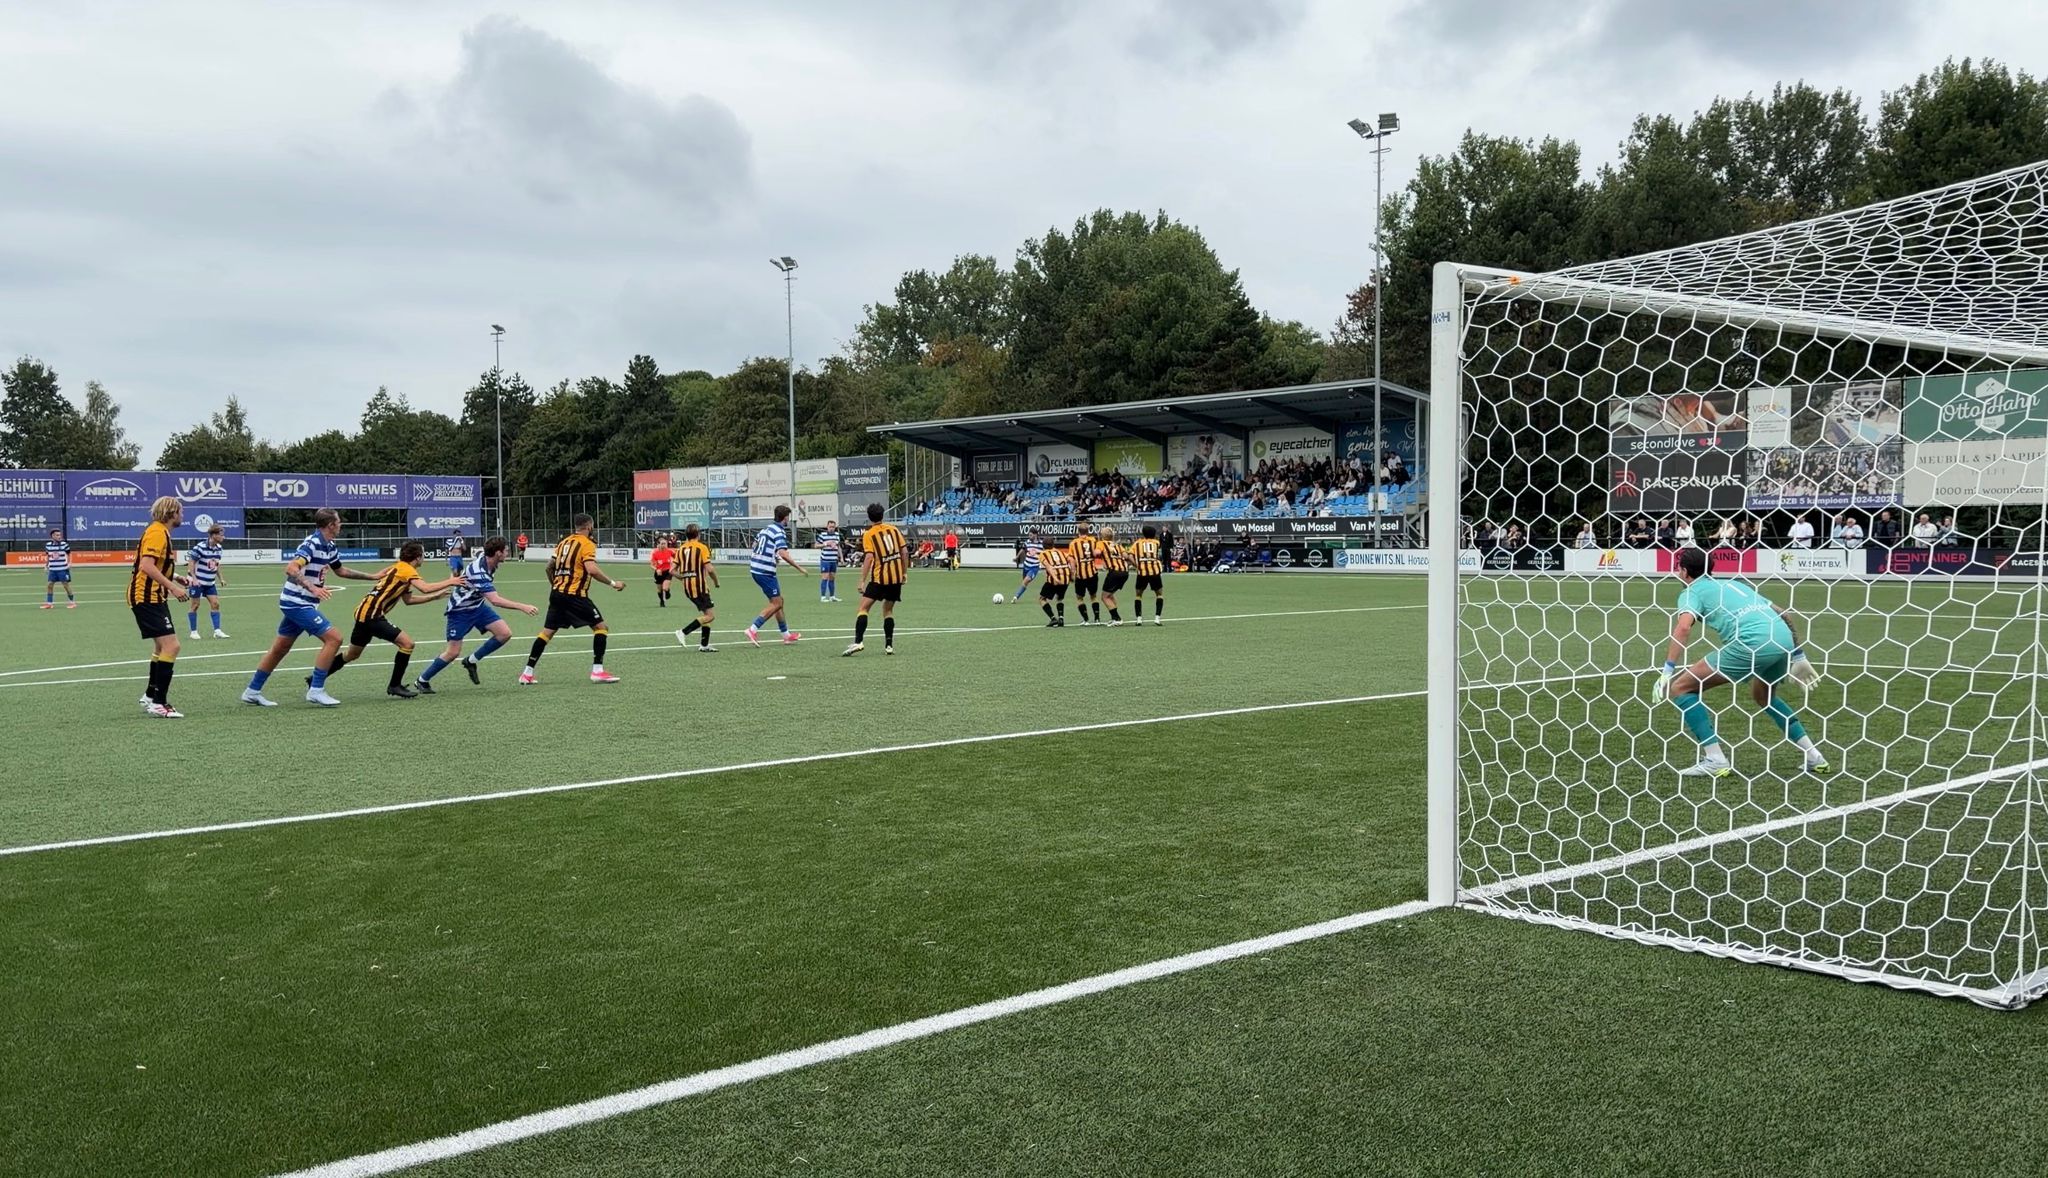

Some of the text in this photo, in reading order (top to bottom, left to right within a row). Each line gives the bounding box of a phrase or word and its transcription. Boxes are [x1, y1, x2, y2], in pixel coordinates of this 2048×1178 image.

[1269, 437, 1332, 453] eyecatcher
[1630, 437, 1696, 450] secondlove
[1063, 457, 1088, 467] MARINE
[1973, 454, 1981, 462] &
[179, 478, 223, 493] VKV
[348, 484, 398, 495] NEWES
[1936, 487, 1962, 495] 1000
[86, 487, 137, 496] NIRINT
[674, 500, 705, 515] LOGIX
[429, 517, 475, 525] ZPRESS
[1291, 521, 1336, 532] Van Mossel
[1350, 520, 1399, 531] Van Mssel
[966, 527, 984, 535] Mossel
[1233, 522, 1275, 532] Van Mossel
[1350, 553, 1405, 565] BONNEWITS.NL
